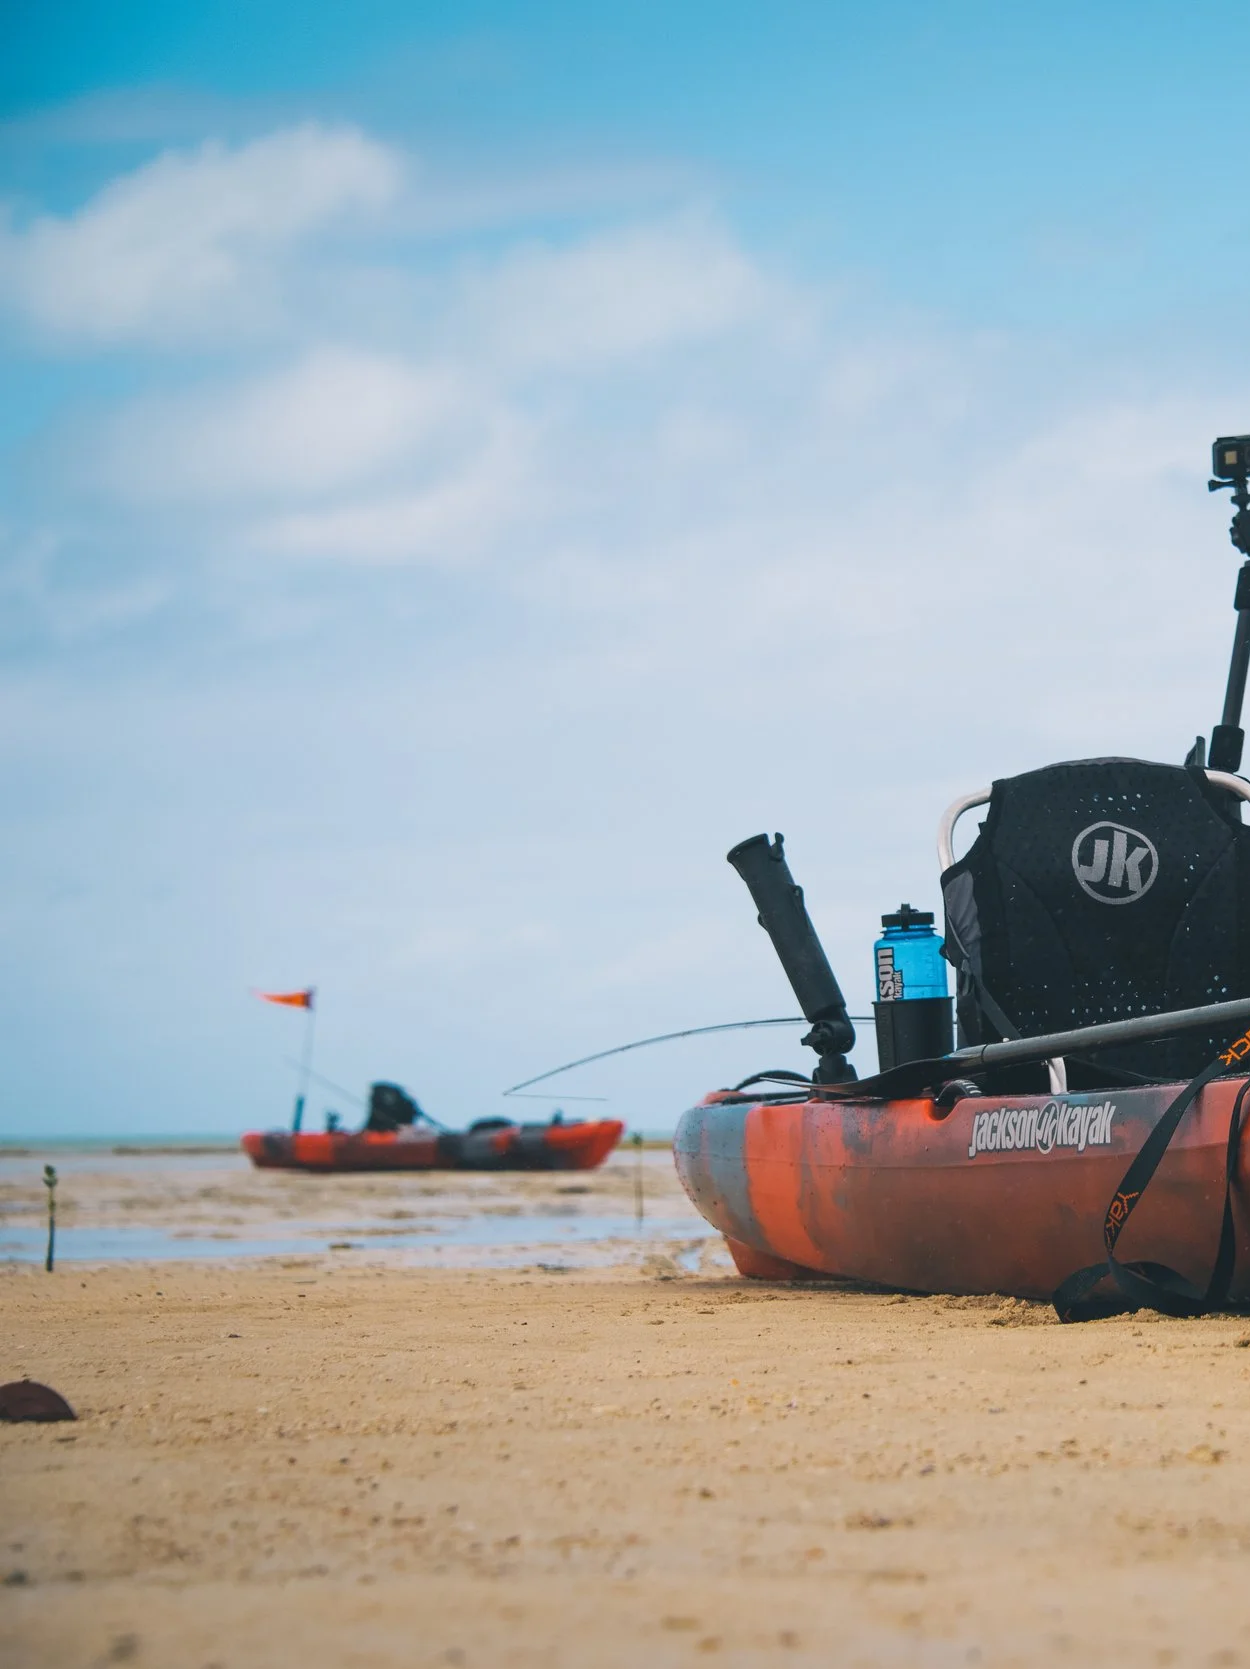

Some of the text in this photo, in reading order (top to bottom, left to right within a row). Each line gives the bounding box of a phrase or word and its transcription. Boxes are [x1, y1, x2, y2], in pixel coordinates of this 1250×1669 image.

[893, 971, 903, 1000] kayak
[968, 1106, 1039, 1157] jackson
[1056, 1101, 1117, 1152] kayak
